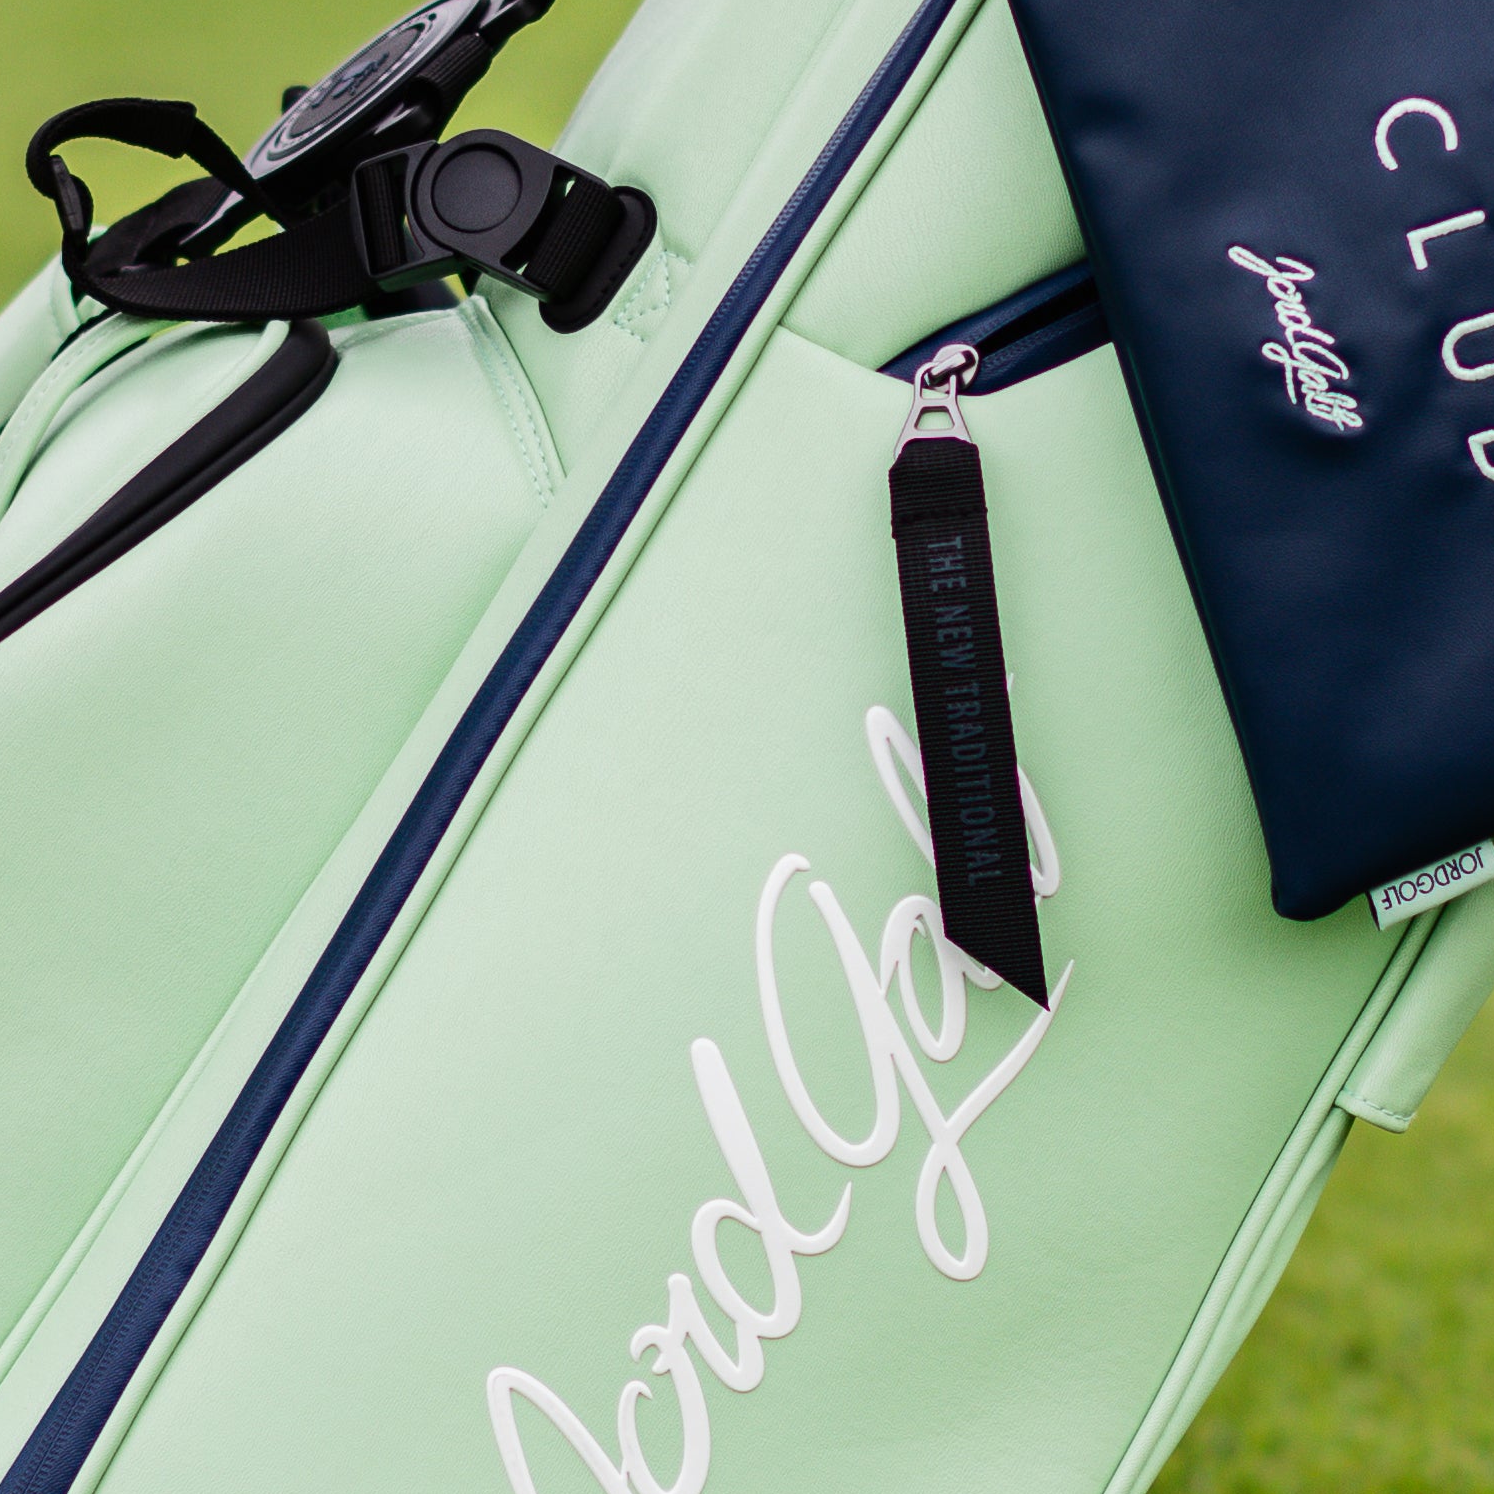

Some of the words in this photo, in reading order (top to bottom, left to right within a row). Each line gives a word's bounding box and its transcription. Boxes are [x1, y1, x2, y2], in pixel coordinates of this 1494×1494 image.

[927, 535, 967, 592] THE
[935, 605, 977, 668] NEW
[945, 682, 1003, 887] TRADITIONAL
[1381, 846, 1484, 910] JORDGOLF
